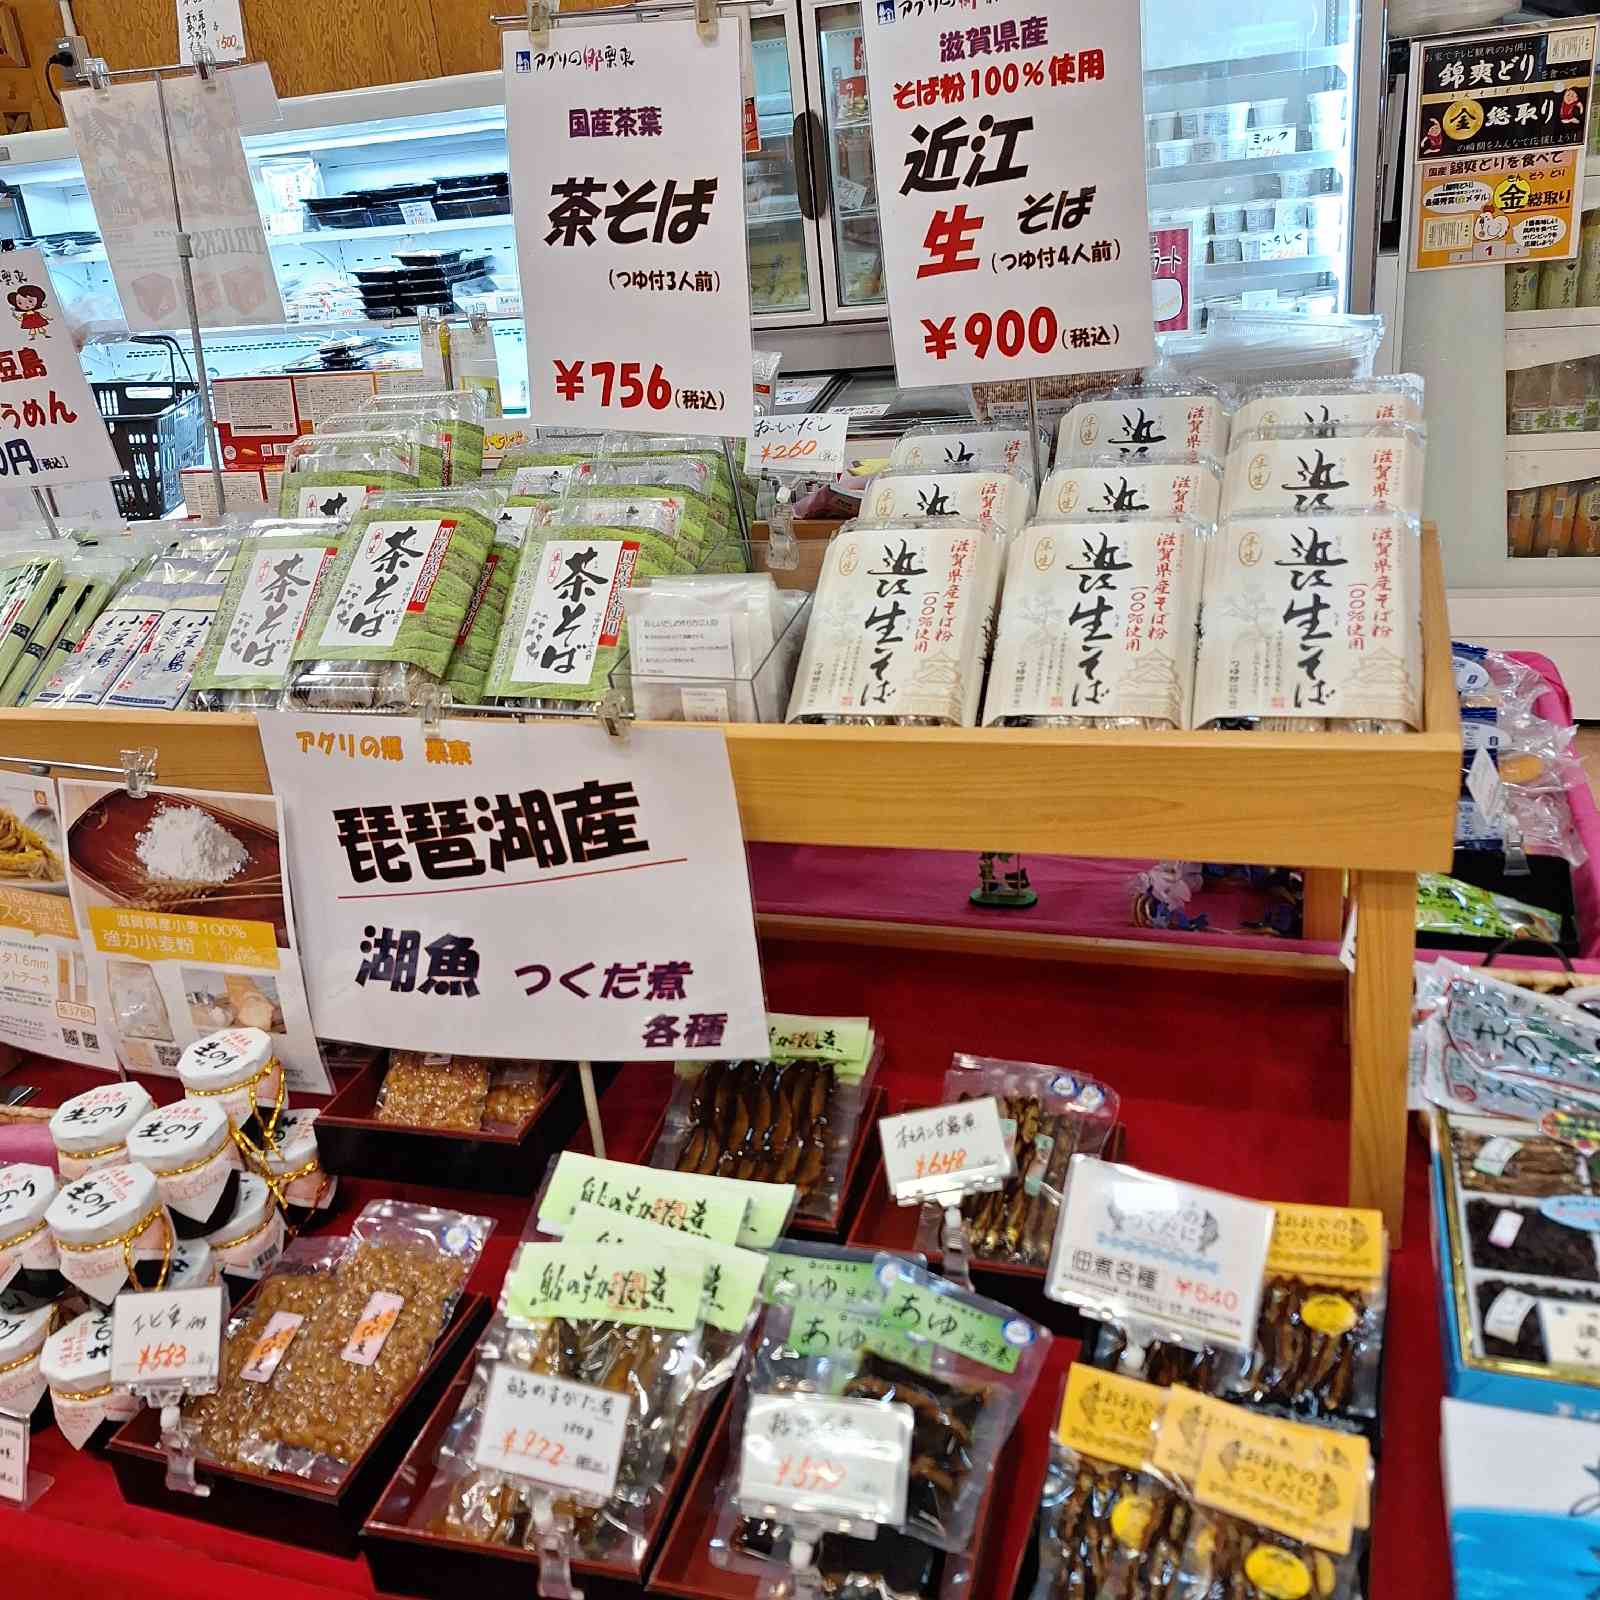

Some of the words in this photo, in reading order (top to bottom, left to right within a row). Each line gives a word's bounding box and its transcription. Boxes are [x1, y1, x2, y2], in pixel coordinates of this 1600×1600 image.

[939, 16, 1049, 62] 滋賀県産
[893, 48, 1105, 110] そば粉100%使用
[1438, 54, 1535, 89] 錦爽どり
[569, 106, 663, 138] 国産茶葉
[1253, 131, 1288, 144] ミルク
[1450, 107, 1477, 131] 金
[1485, 99, 1555, 128] 総取り
[899, 115, 1034, 196] 近江
[544, 177, 718, 247] 茶そば
[1500, 184, 1527, 208] 金
[916, 204, 985, 279] 生
[1017, 185, 1097, 235] そば
[992, 239, 1121, 274] (つゆ付4人前)
[609, 269, 721, 292] (つゆ付3人前)
[920, 306, 1058, 360] ¥900
[1061, 324, 1120, 350] (税込)
[553, 359, 672, 411] ¥756
[675, 389, 726, 411] (税込)
[761, 440, 817, 463] ¥260
[349, 526, 424, 637] 茶そば
[242, 554, 310, 667] 茶そば
[540, 546, 609, 674] 茶そば
[860, 539, 928, 706] 近江生そば
[1066, 531, 1133, 707] 近江生そば
[1274, 527, 1349, 709] 近江生そば
[296, 731, 403, 761] アグリの郷
[425, 737, 472, 766] 栗東
[332, 780, 650, 884] 琵琶湖産
[354, 925, 481, 998] 湖魚
[514, 961, 694, 1001] つくだ煮
[641, 1012, 728, 1048] 各種
[894, 1291, 957, 1336] あゆ
